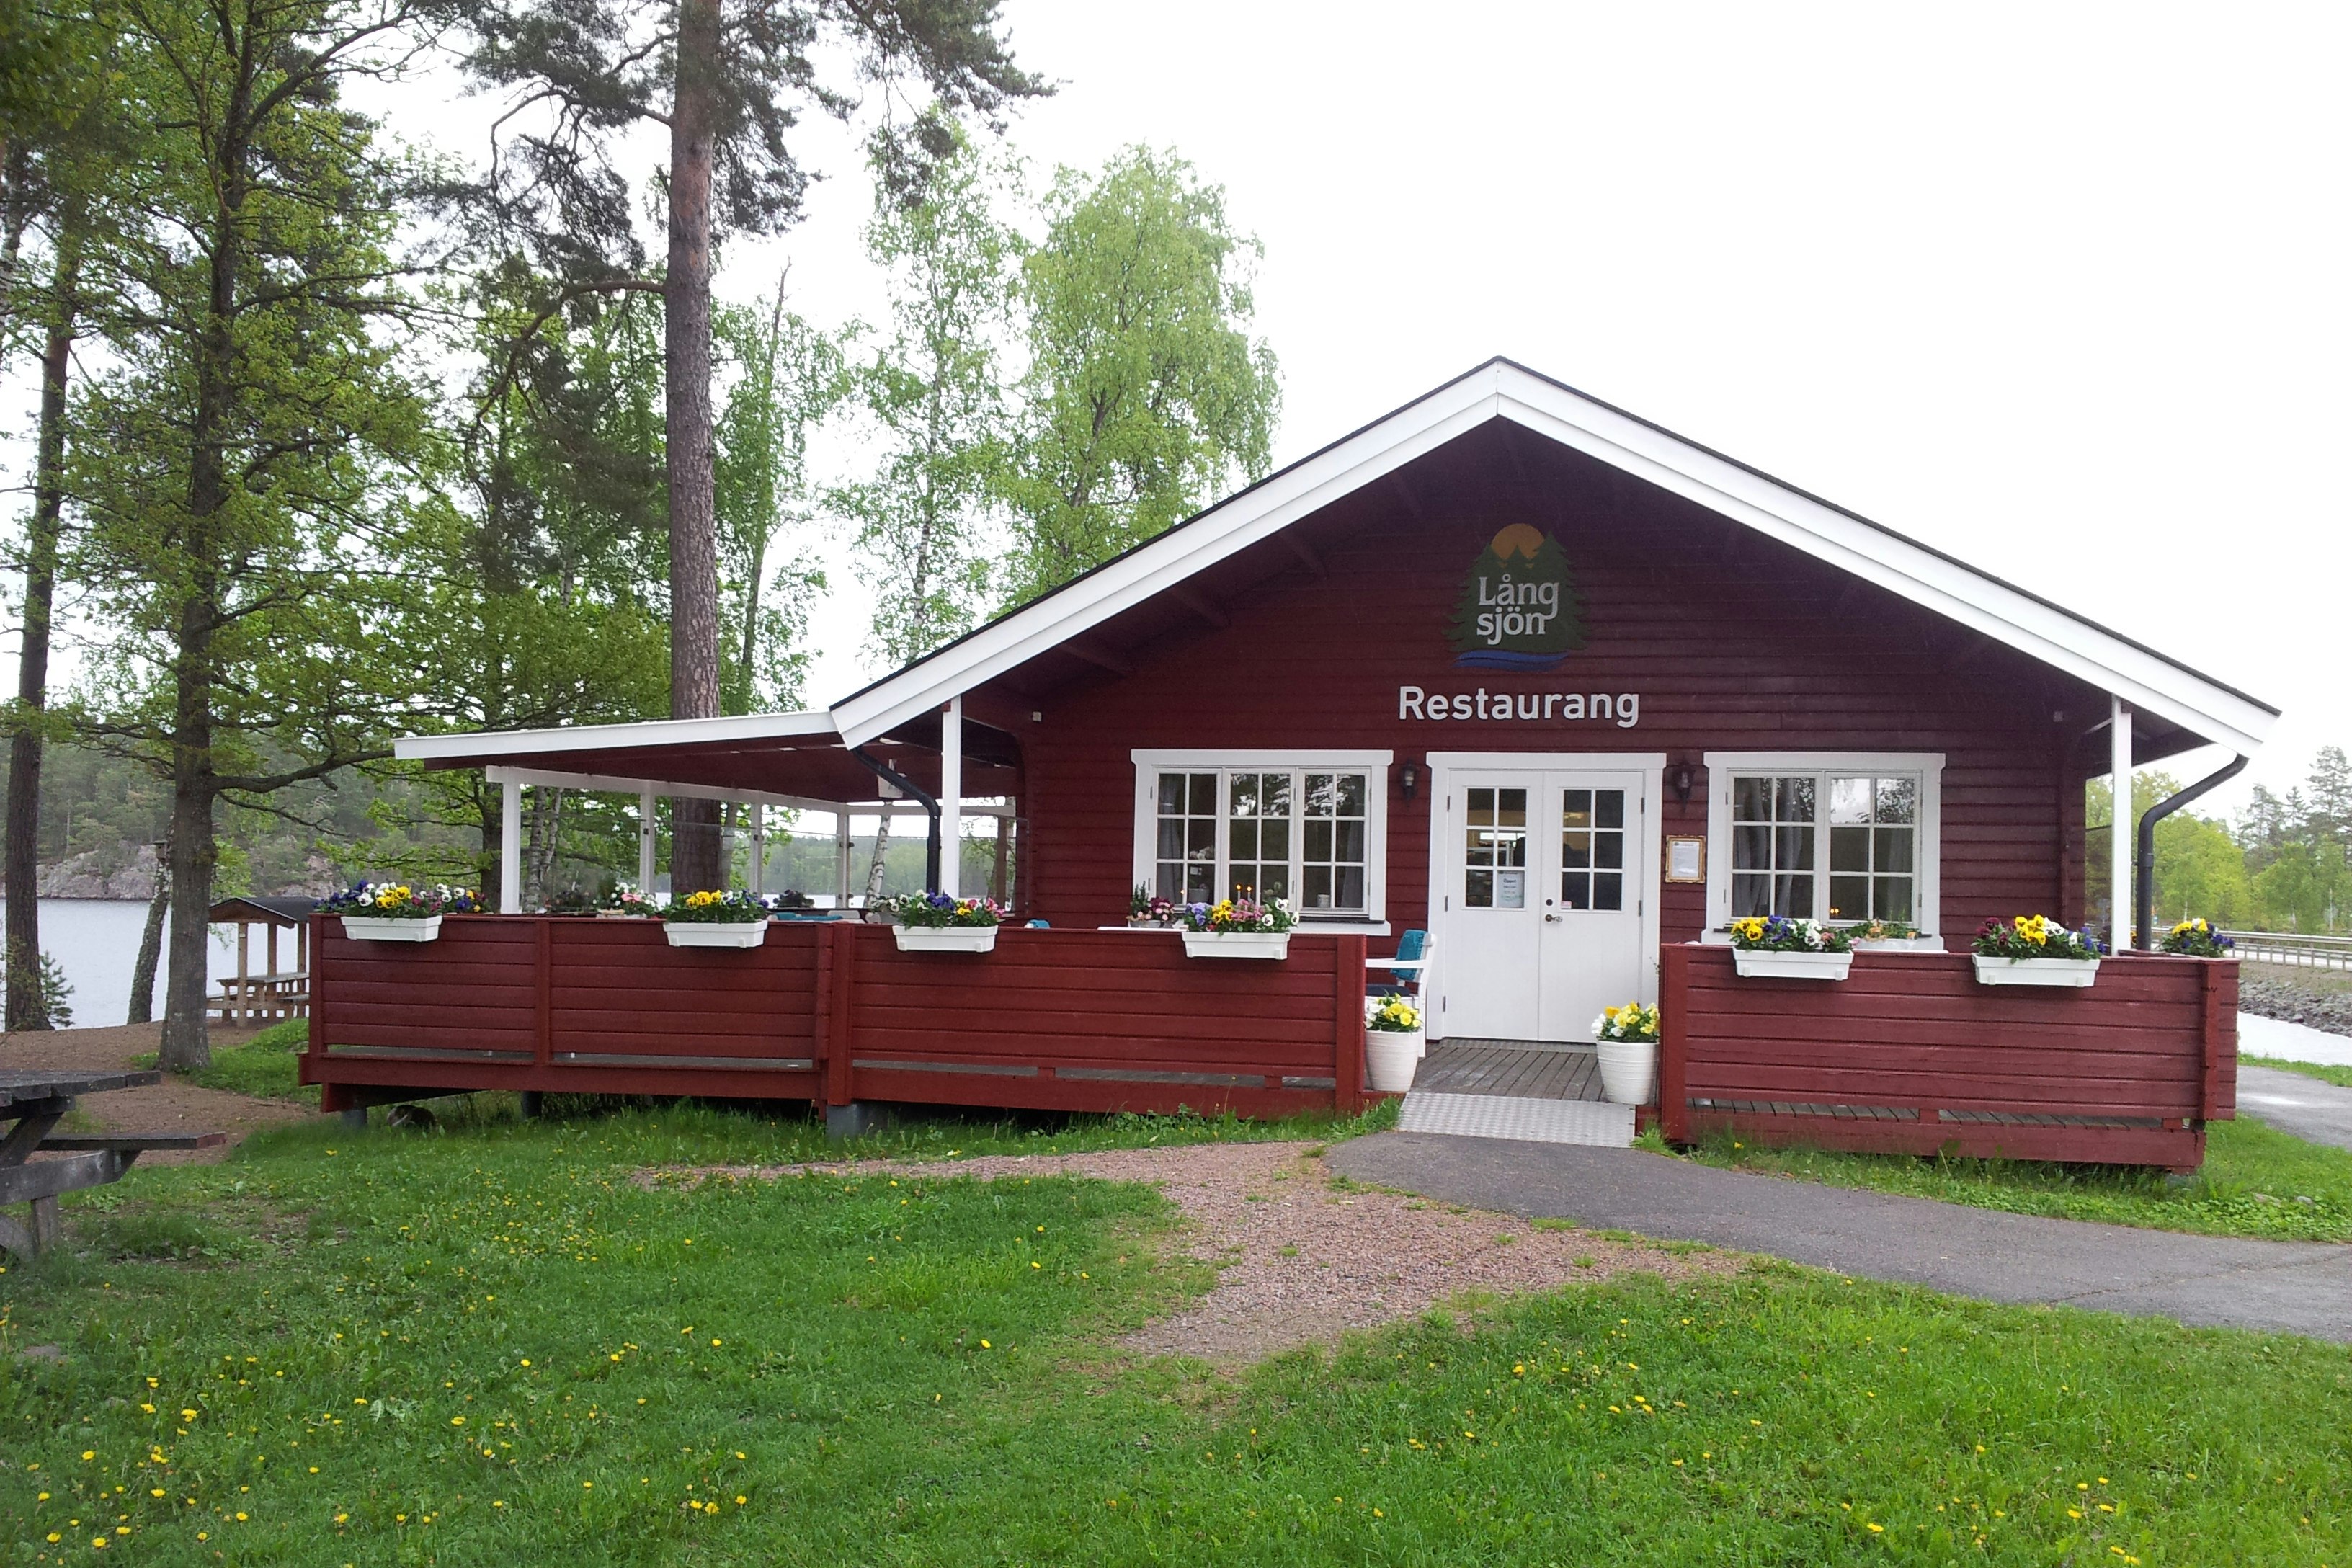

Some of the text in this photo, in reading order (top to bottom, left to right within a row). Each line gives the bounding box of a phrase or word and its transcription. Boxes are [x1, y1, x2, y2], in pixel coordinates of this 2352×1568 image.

[1479, 574, 1559, 620] Lång
[1476, 606, 1546, 645] sjön
[1399, 685, 1639, 728] Restaurang
